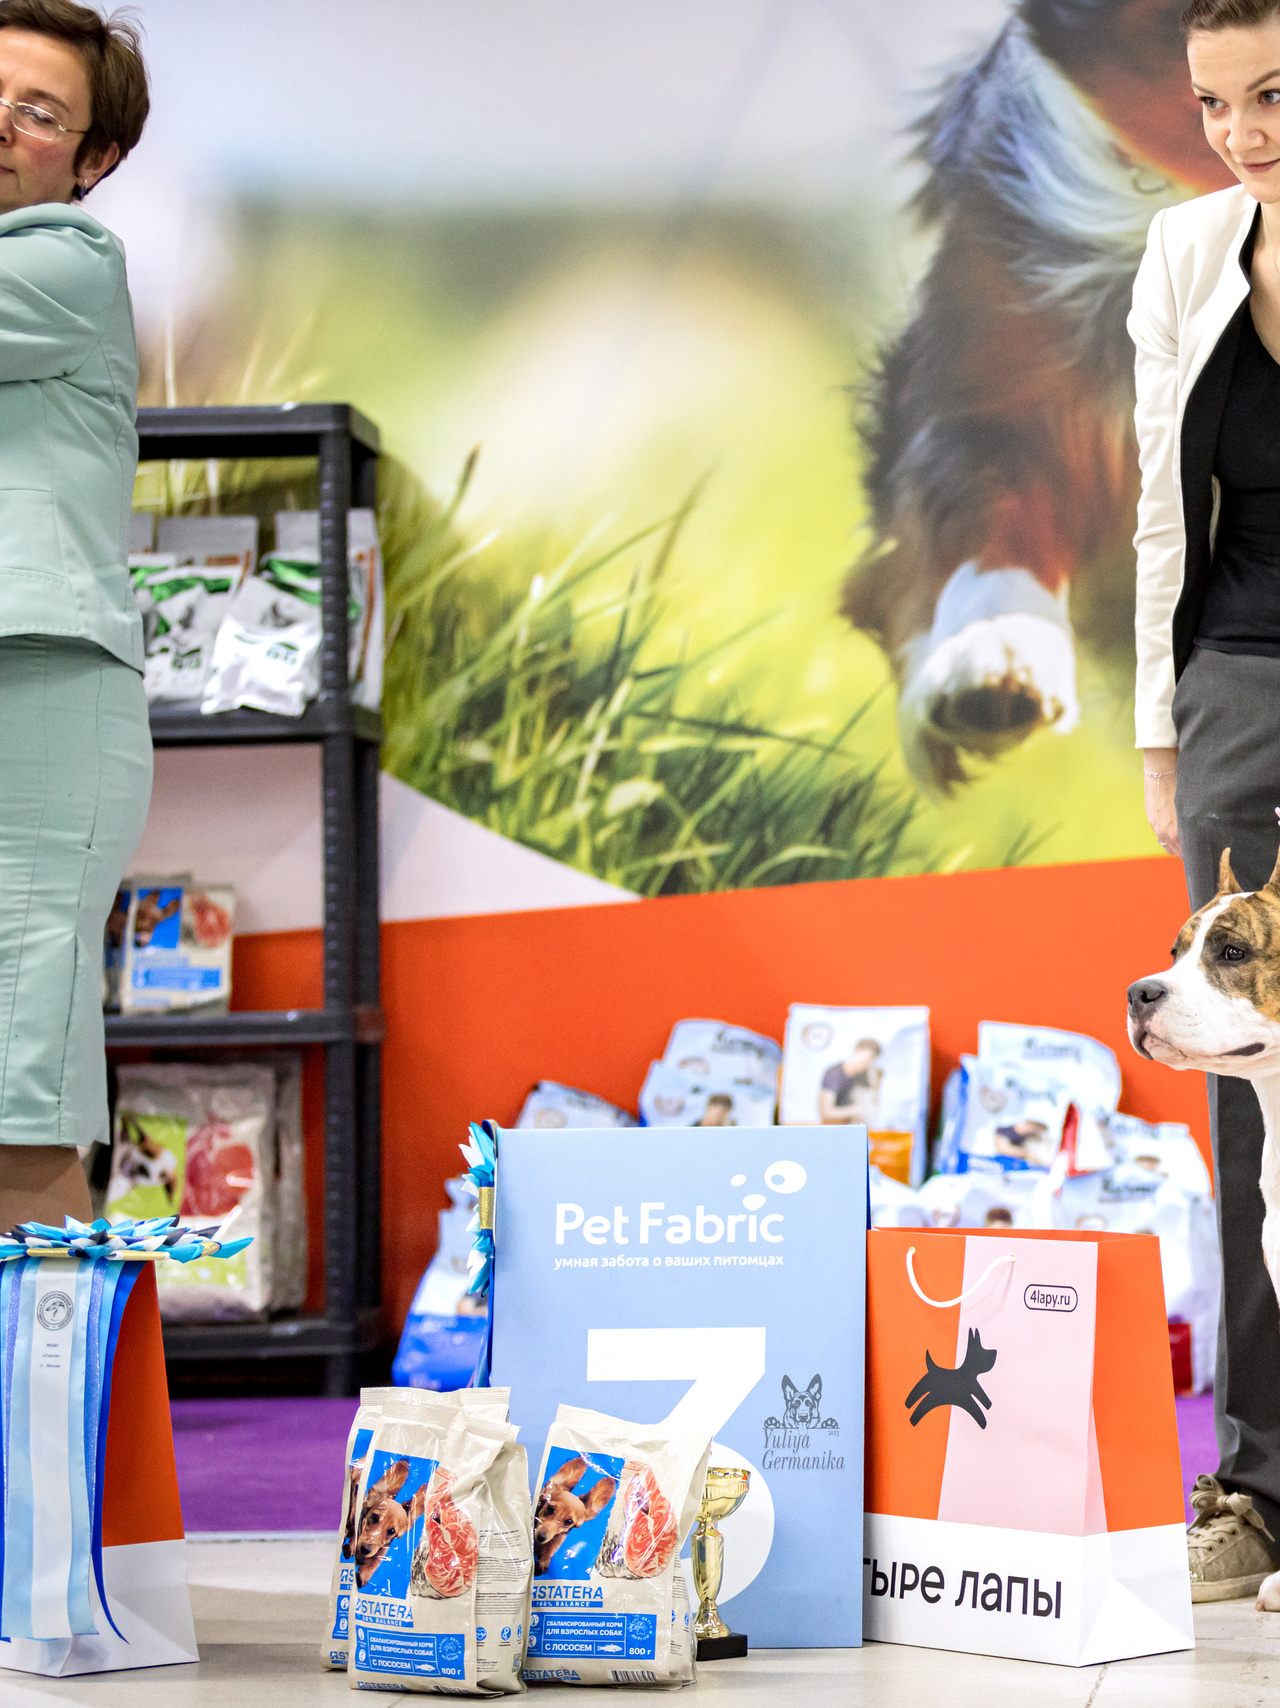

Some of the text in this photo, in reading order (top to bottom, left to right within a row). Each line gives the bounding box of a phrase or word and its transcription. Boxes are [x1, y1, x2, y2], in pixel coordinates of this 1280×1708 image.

[555, 1202, 785, 1245] Pet Fabric
[554, 1254, 784, 1270] умная забота о ваших питомцах
[1030, 1290, 1071, 1308] 4lapy.ru
[954, 1570, 1062, 1619] лапы
[376, 1617, 402, 1627] BALANCE
[546, 1619, 606, 1628] СБАЛАНСИРОВАННЫЙ
[545, 1628, 559, 1636] ДЛЯ
[560, 1628, 599, 1636] ВЗРОСЛЫХ
[370, 1636, 418, 1648] СБАЛАНСИРОВАННЫЙ
[545, 1643, 592, 1652] С ЛОСОСЕМ
[370, 1644, 434, 1657] ДЛЯ ВЗРОСЛЫХ СОБАК
[629, 1647, 646, 1655] 800
[372, 1658, 411, 1670] С ЛОСОСЕМ
